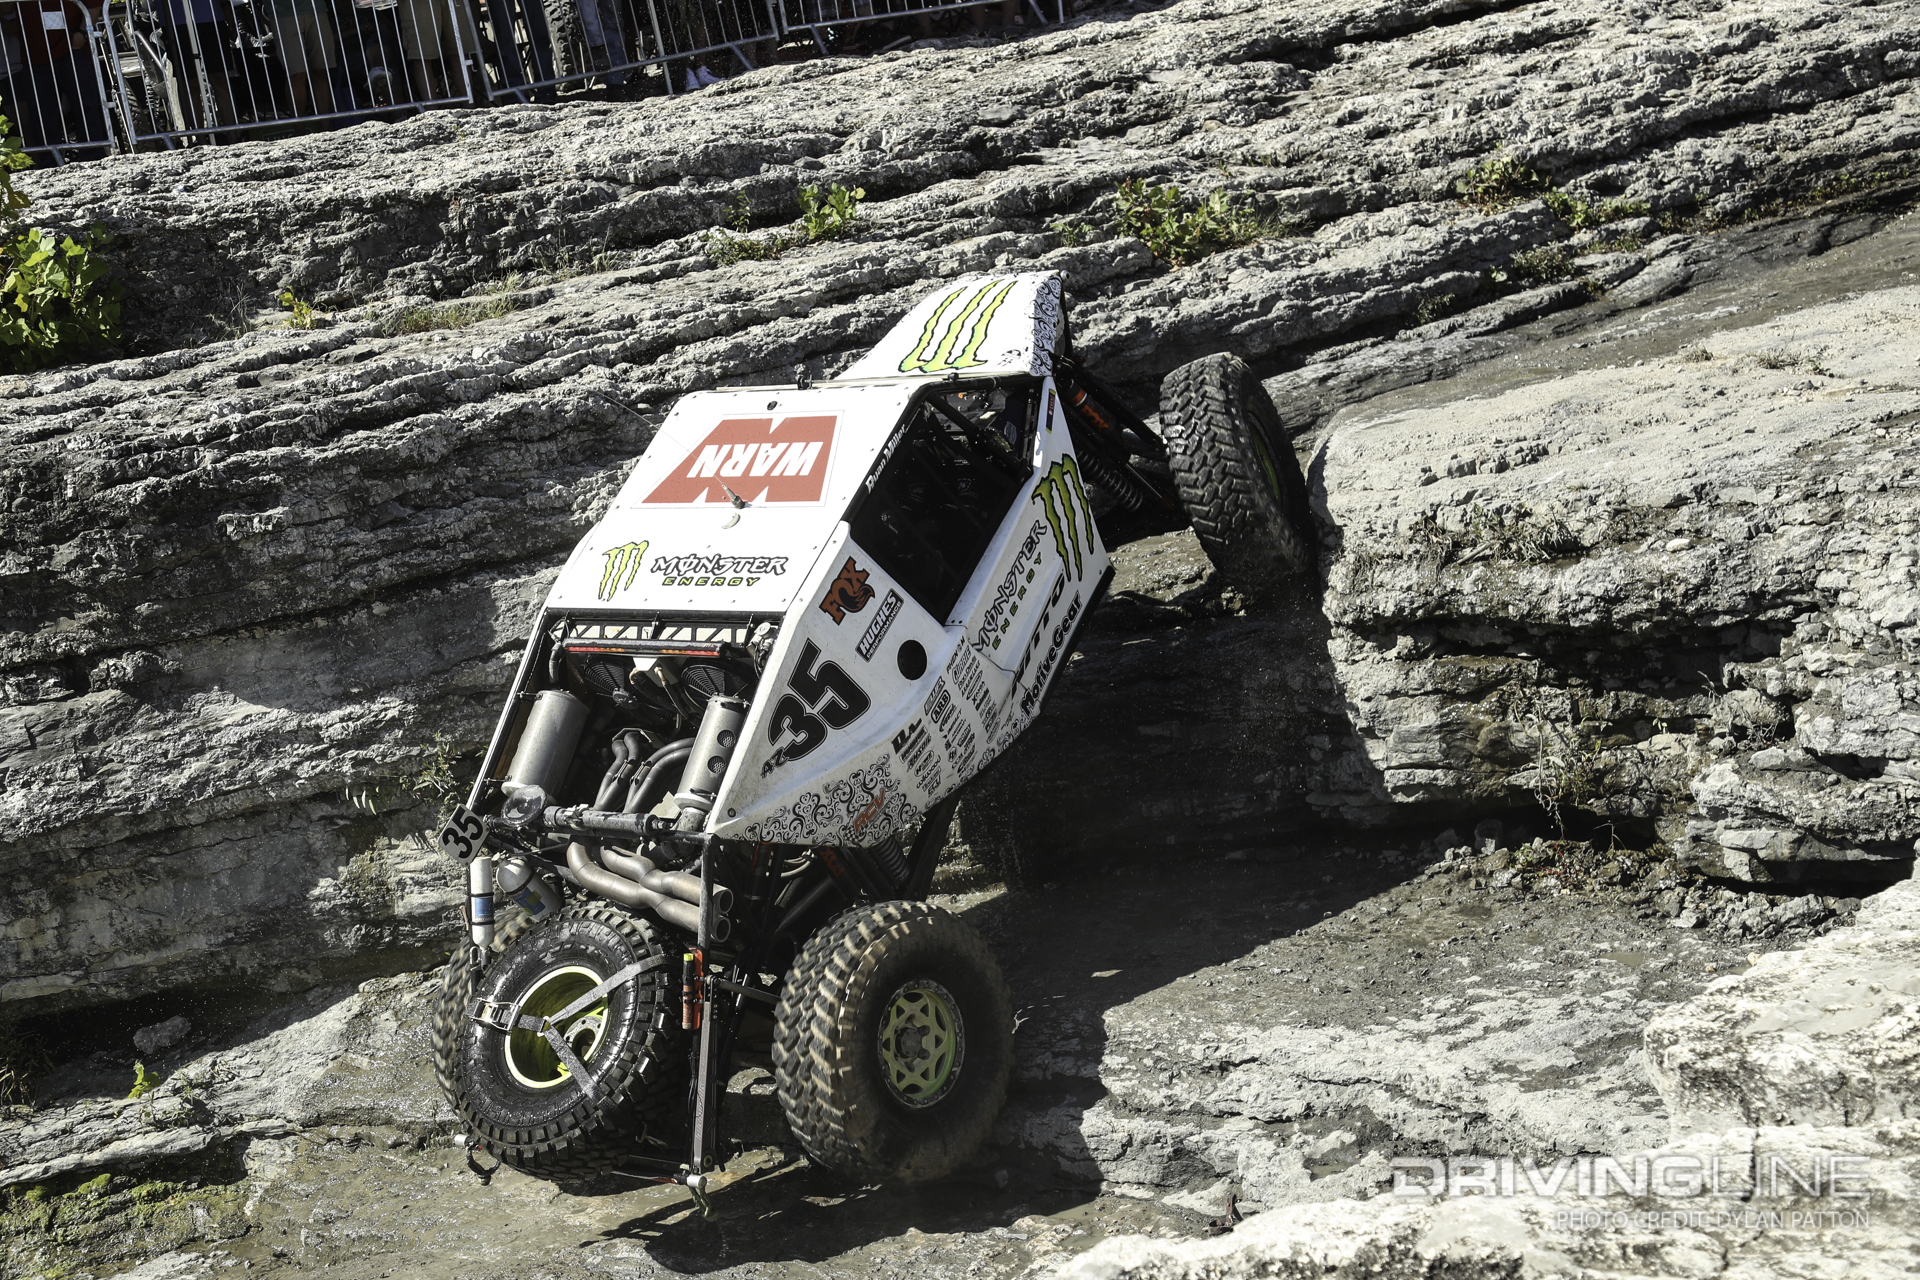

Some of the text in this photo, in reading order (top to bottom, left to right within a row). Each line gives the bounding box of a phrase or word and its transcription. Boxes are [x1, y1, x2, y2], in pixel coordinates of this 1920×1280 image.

[686, 441, 818, 478] WARN
[883, 423, 906, 461] Miller
[650, 554, 789, 575] MONSTER
[662, 577, 761, 586] ENERGY
[818, 556, 876, 626] FOX
[970, 520, 1048, 653] MONSTER
[858, 591, 897, 655] HUGHES
[866, 600, 901, 658] PERFORMANCE
[992, 553, 1043, 650] ENERGY
[769, 637, 872, 762] 35
[933, 693, 948, 719] ARB
[442, 807, 483, 859] 35
